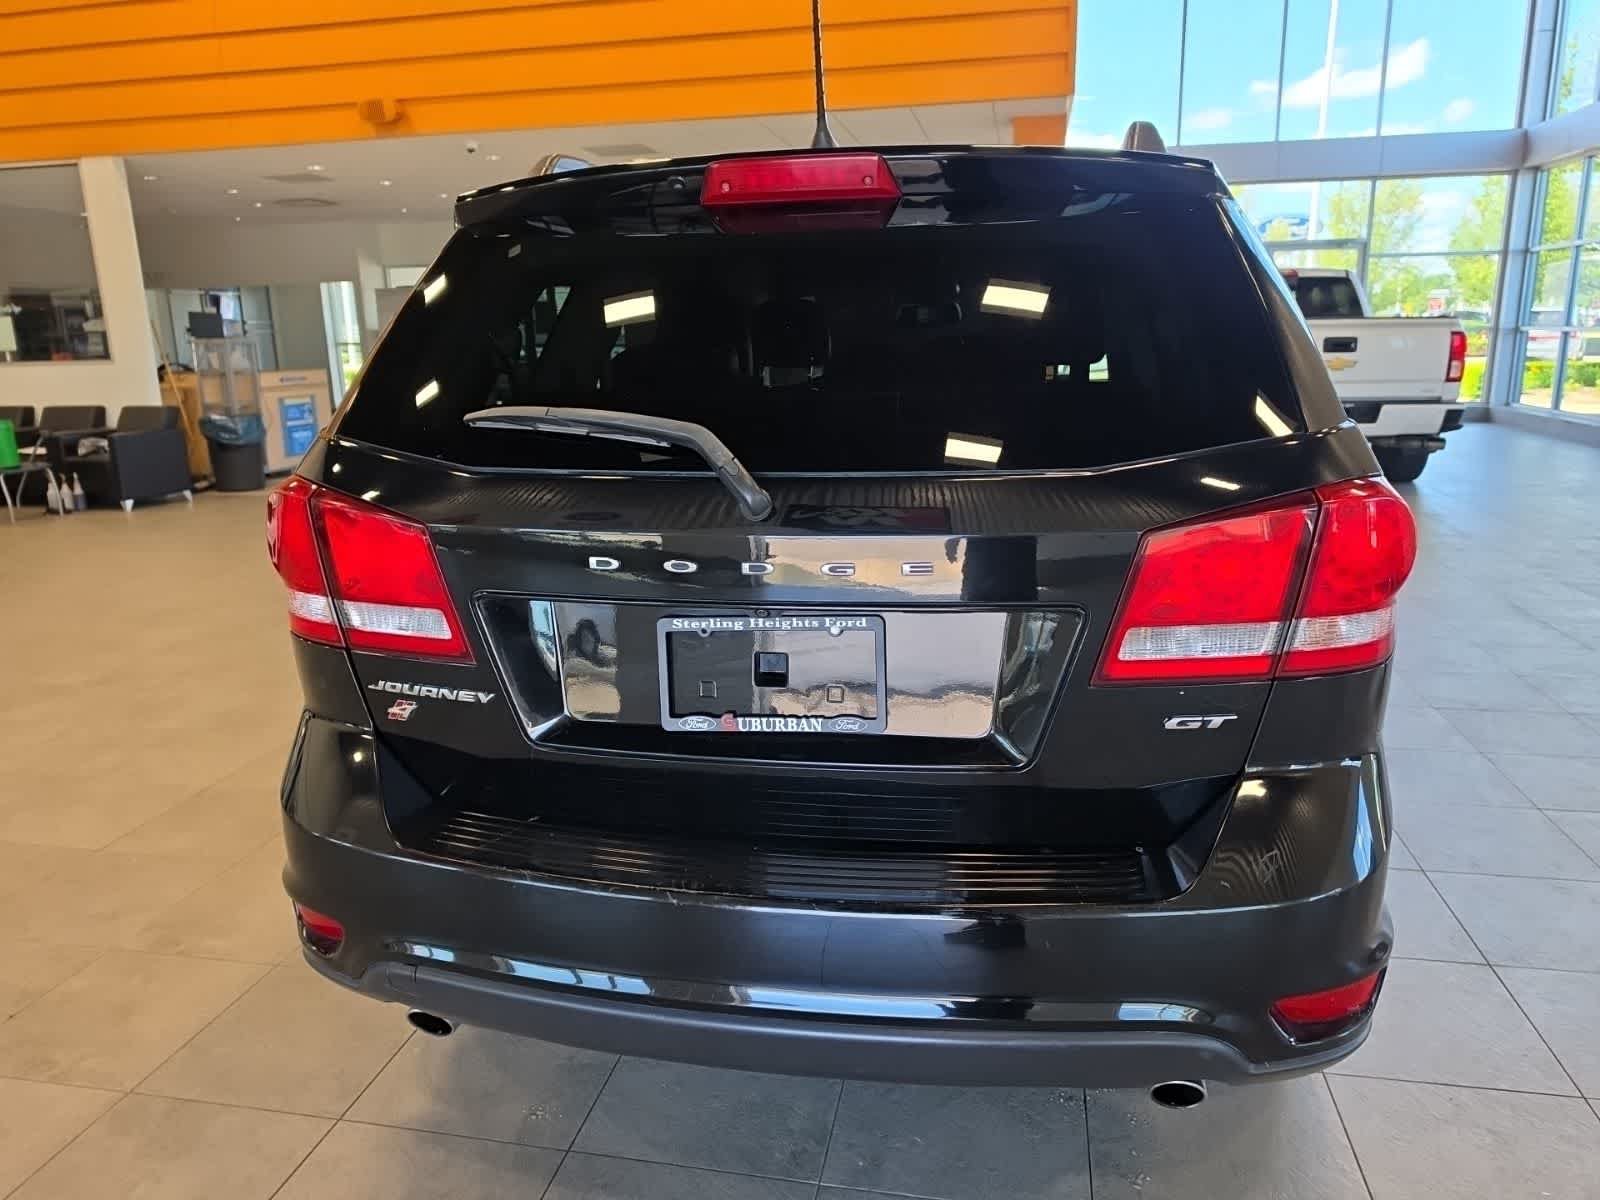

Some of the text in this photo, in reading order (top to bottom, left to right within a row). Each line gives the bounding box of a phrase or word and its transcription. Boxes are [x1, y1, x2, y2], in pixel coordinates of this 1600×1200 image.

[588, 556, 935, 576] DODGE
[671, 616, 868, 631] Sterling Heights Ford
[367, 679, 497, 704] JOURNEY
[720, 713, 824, 732] SUBURBAN
[1163, 713, 1239, 730] GT
